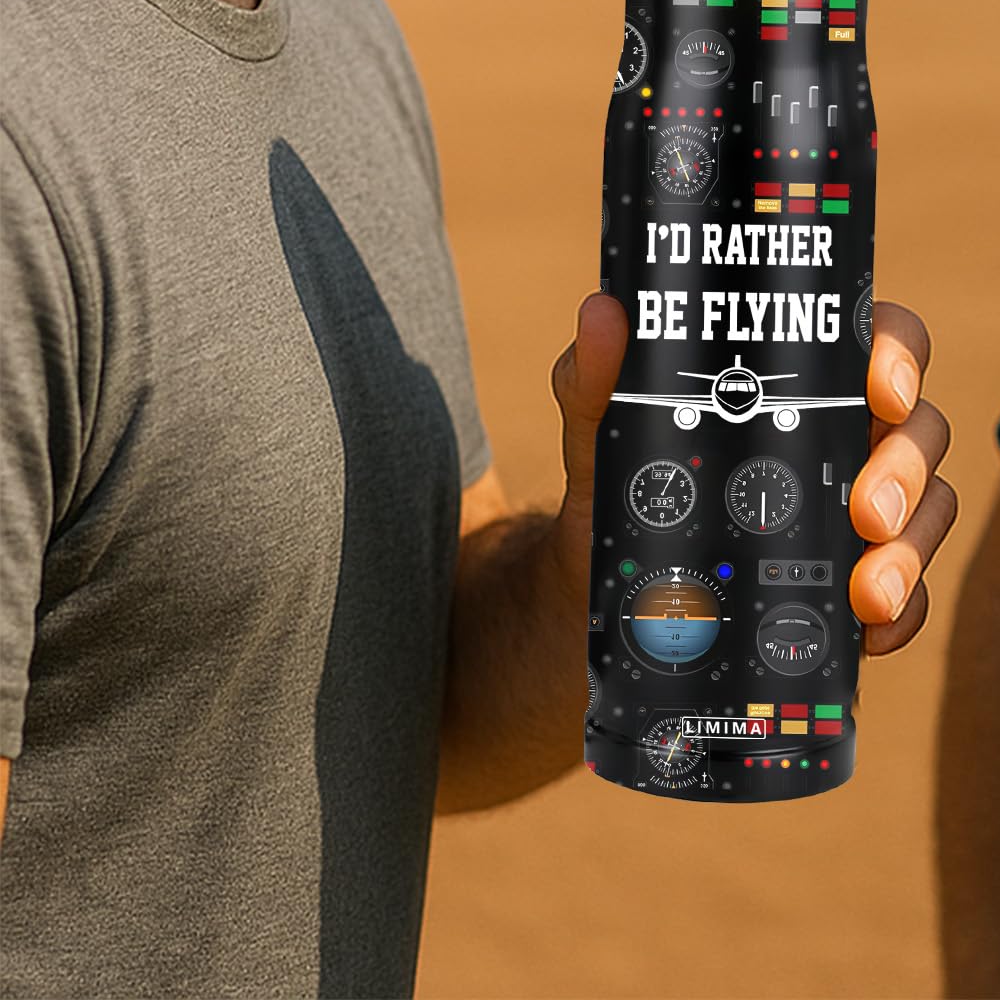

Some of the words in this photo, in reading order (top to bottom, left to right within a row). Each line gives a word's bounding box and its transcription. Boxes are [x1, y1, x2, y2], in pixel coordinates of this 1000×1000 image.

[633, 46, 638, 54] 2
[702, 224, 832, 266] RATHER
[636, 290, 688, 340] BE
[702, 292, 840, 342] FLYING
[685, 720, 762, 736] LIMIMA
